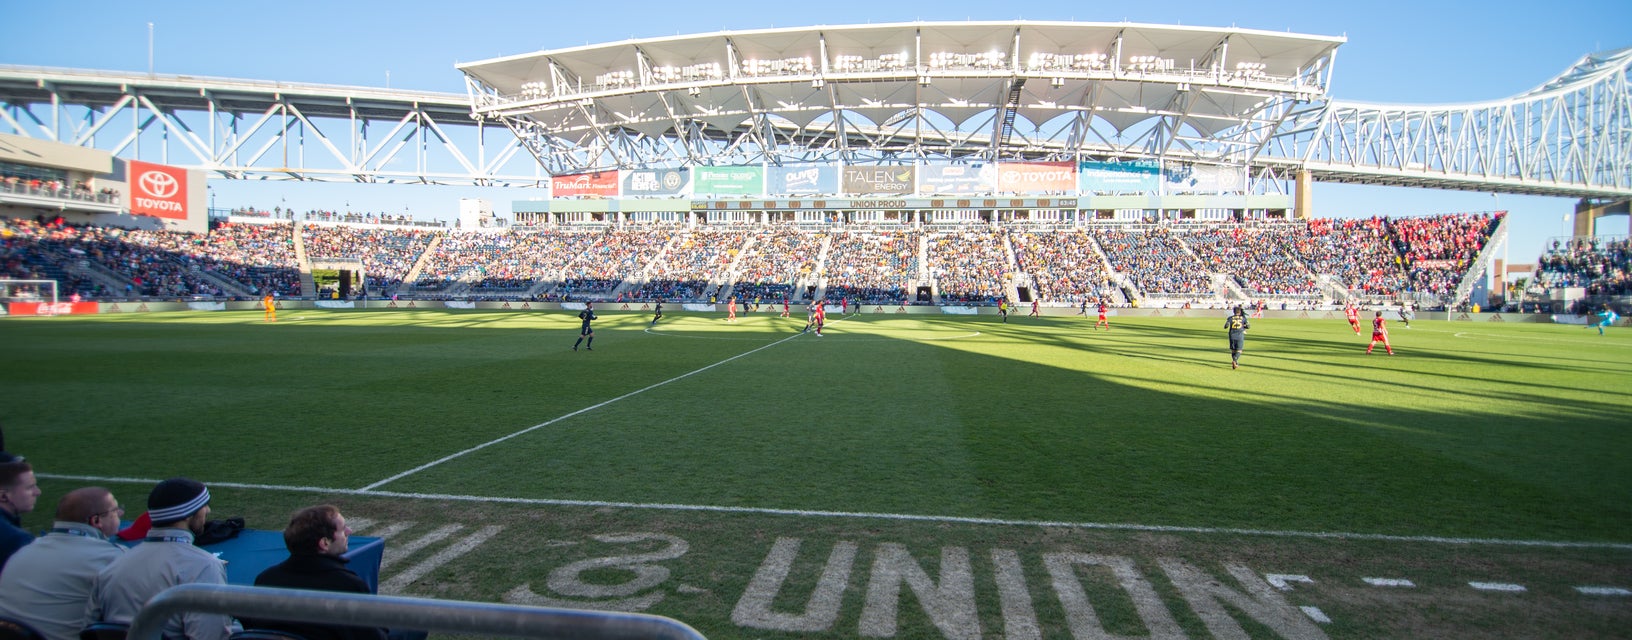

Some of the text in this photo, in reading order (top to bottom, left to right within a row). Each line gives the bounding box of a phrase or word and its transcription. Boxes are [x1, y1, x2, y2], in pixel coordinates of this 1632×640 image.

[786, 168, 819, 182] OLIVER
[847, 170, 895, 183] TALEN
[1022, 171, 1072, 182] TOYOTA
[555, 181, 592, 190] TruMark
[135, 198, 183, 212] TOYOTA
[850, 200, 907, 208] UNION PROUD
[1231, 319, 1243, 329] 25
[731, 535, 1328, 640] UNION
